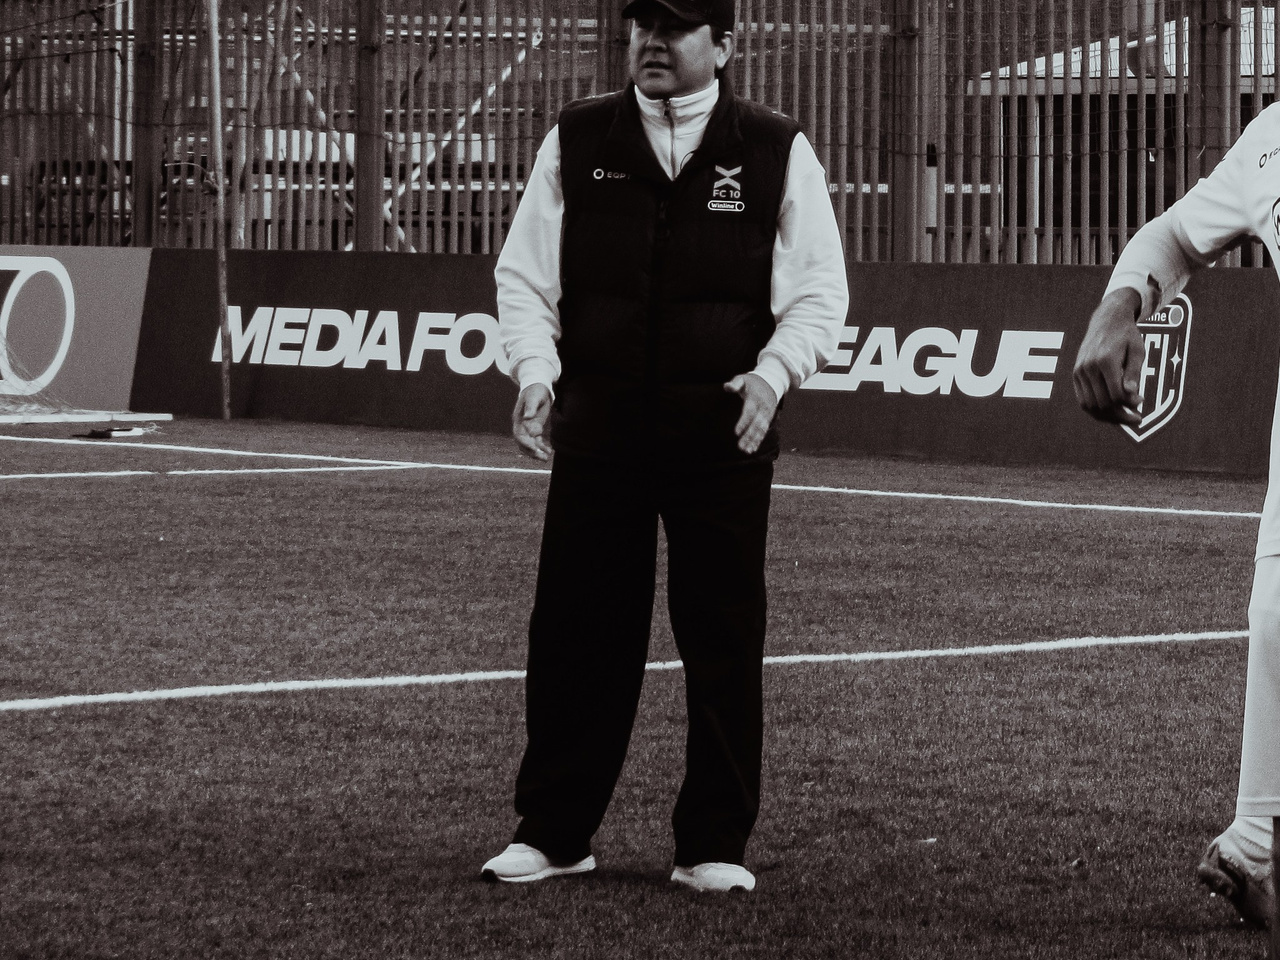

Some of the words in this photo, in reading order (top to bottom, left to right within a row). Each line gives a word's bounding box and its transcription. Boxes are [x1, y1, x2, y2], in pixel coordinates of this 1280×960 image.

[712, 189, 726, 198] FC
[730, 189, 741, 199] 10
[212, 305, 402, 371] MEDIA
[407, 311, 509, 377] FO
[800, 326, 1065, 399] EAGUE
